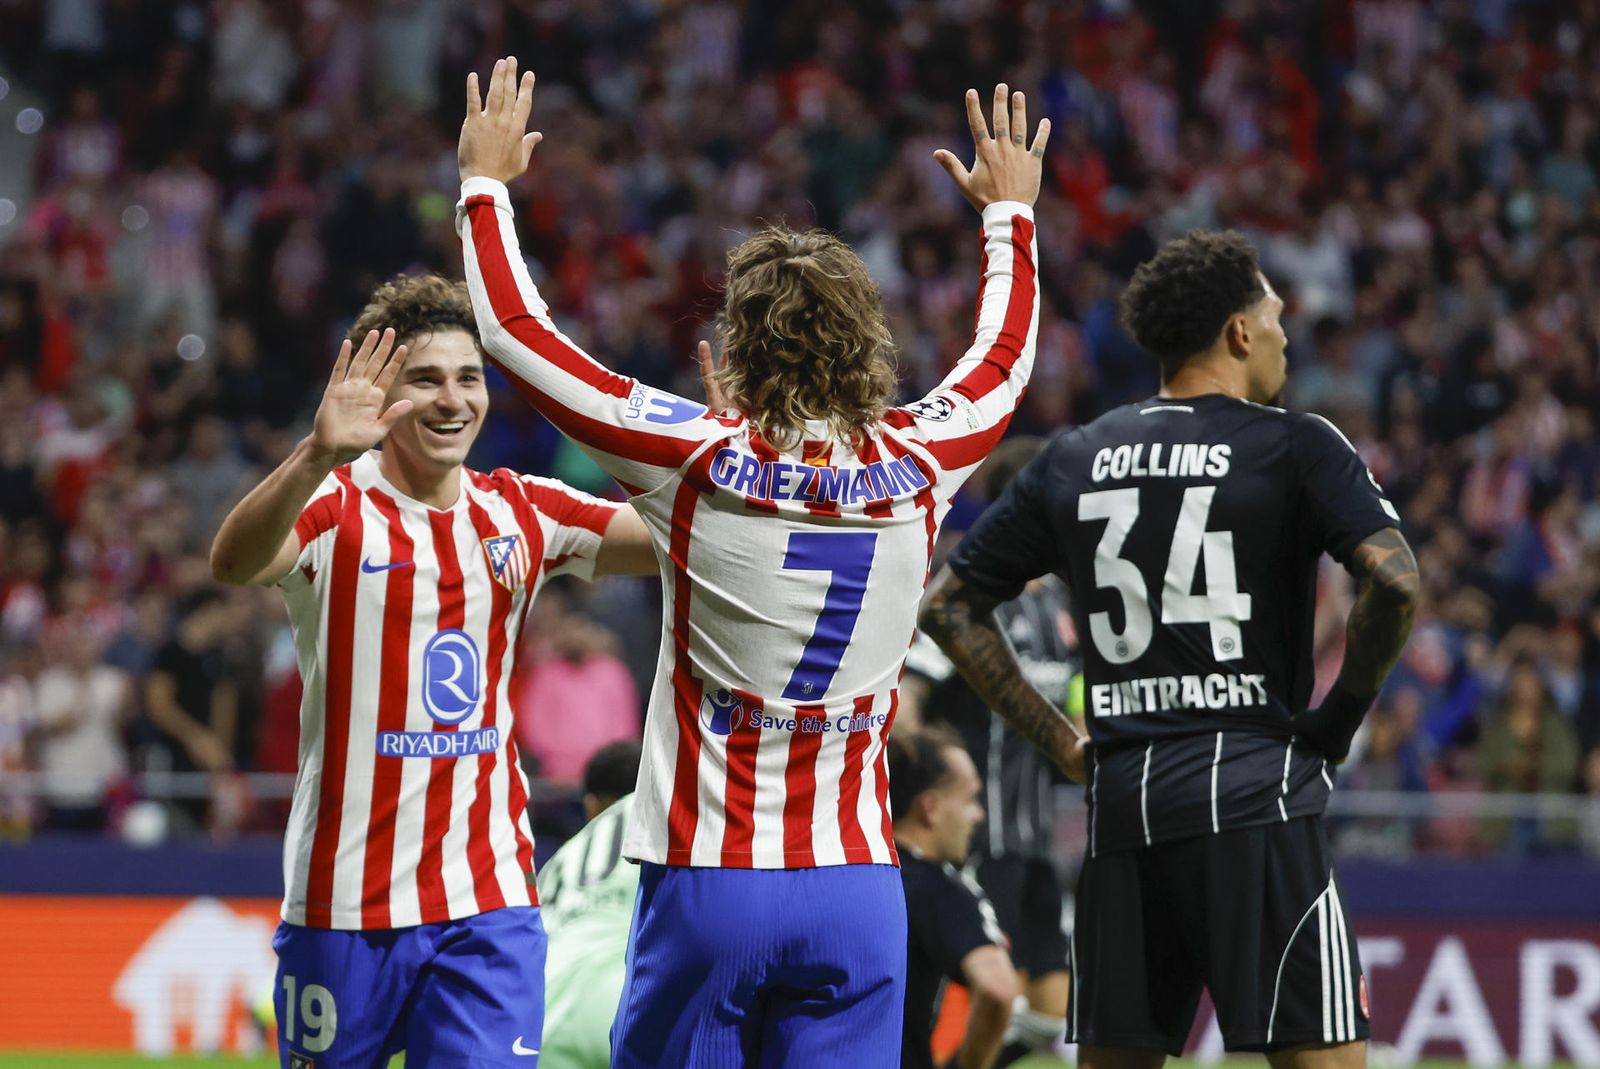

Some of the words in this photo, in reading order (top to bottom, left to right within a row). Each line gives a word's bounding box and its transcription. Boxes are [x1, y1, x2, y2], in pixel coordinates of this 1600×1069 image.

[709, 447, 930, 506] GRIEZMANN
[1091, 442, 1232, 482] COLLINS
[1077, 485, 1252, 665] 34
[780, 532, 879, 702] 7
[749, 709, 798, 732] Save
[801, 716, 832, 733] the
[837, 712, 887, 733] Childre
[1091, 673, 1268, 718] EINTRACHT
[383, 733, 468, 755] RIYADH
[471, 729, 497, 751] AIR
[282, 975, 338, 1052] 19
